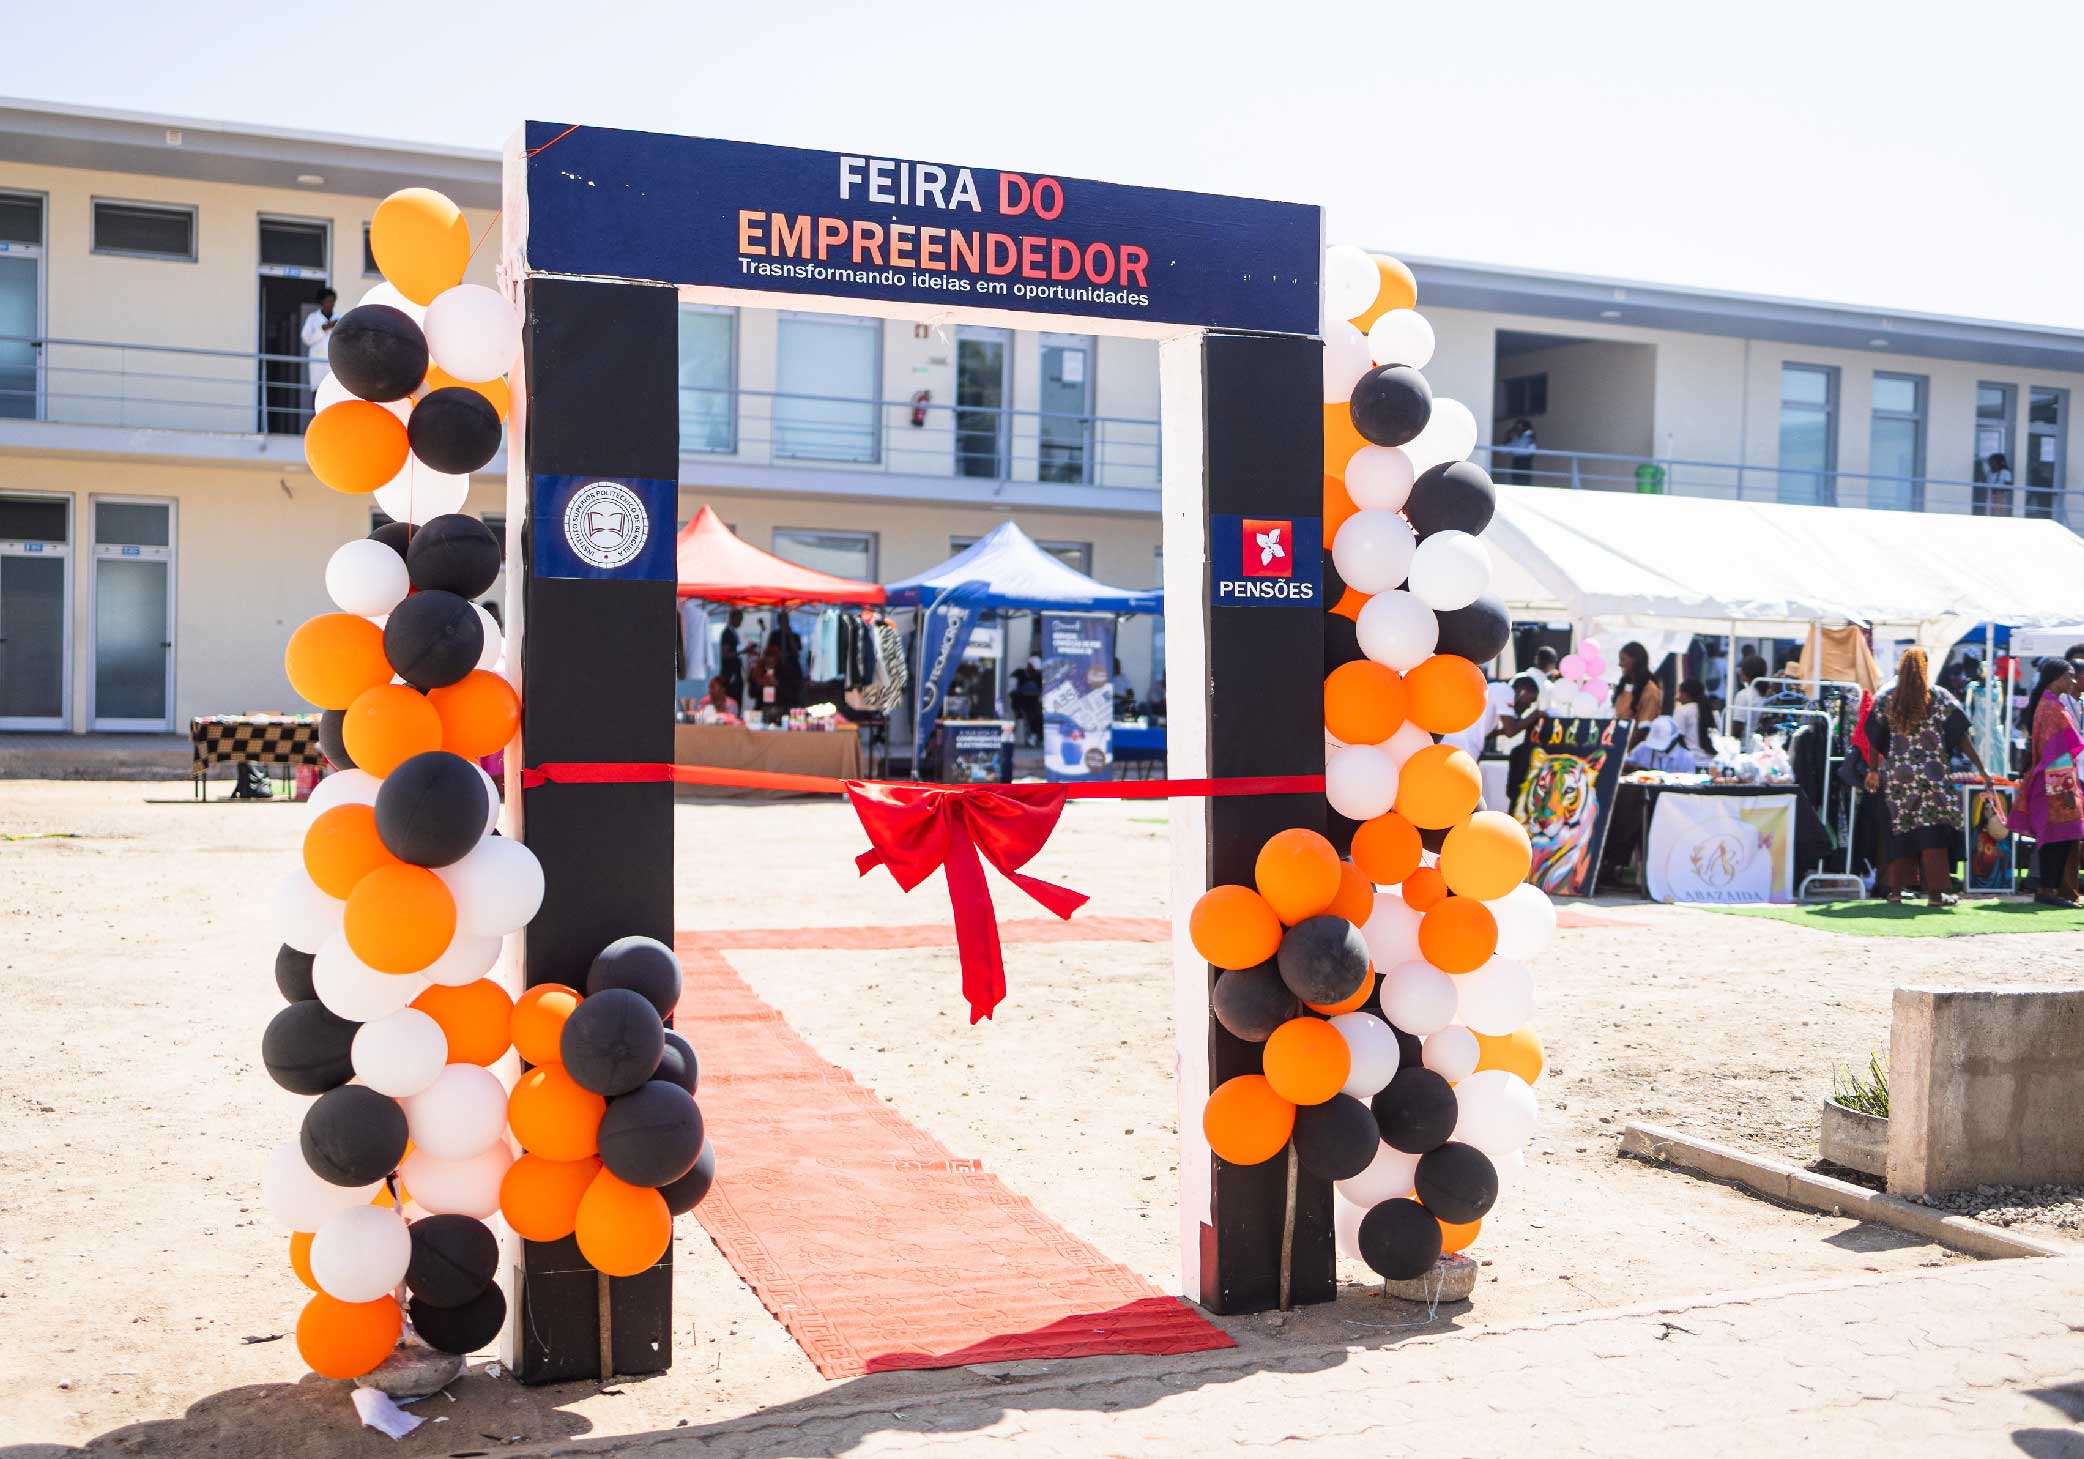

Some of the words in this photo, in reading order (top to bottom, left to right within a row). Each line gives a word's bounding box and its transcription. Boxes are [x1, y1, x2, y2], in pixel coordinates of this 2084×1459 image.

[839, 156, 982, 213] FEIRA
[999, 172, 1064, 221] DO
[738, 209, 1149, 288] EMPREENDEDOR
[738, 257, 906, 287] Trasnsformando
[912, 272, 970, 291] ideias
[976, 279, 1007, 295] em
[1013, 283, 1149, 306] oportunidades
[1220, 579, 1313, 599] PENSÕES
